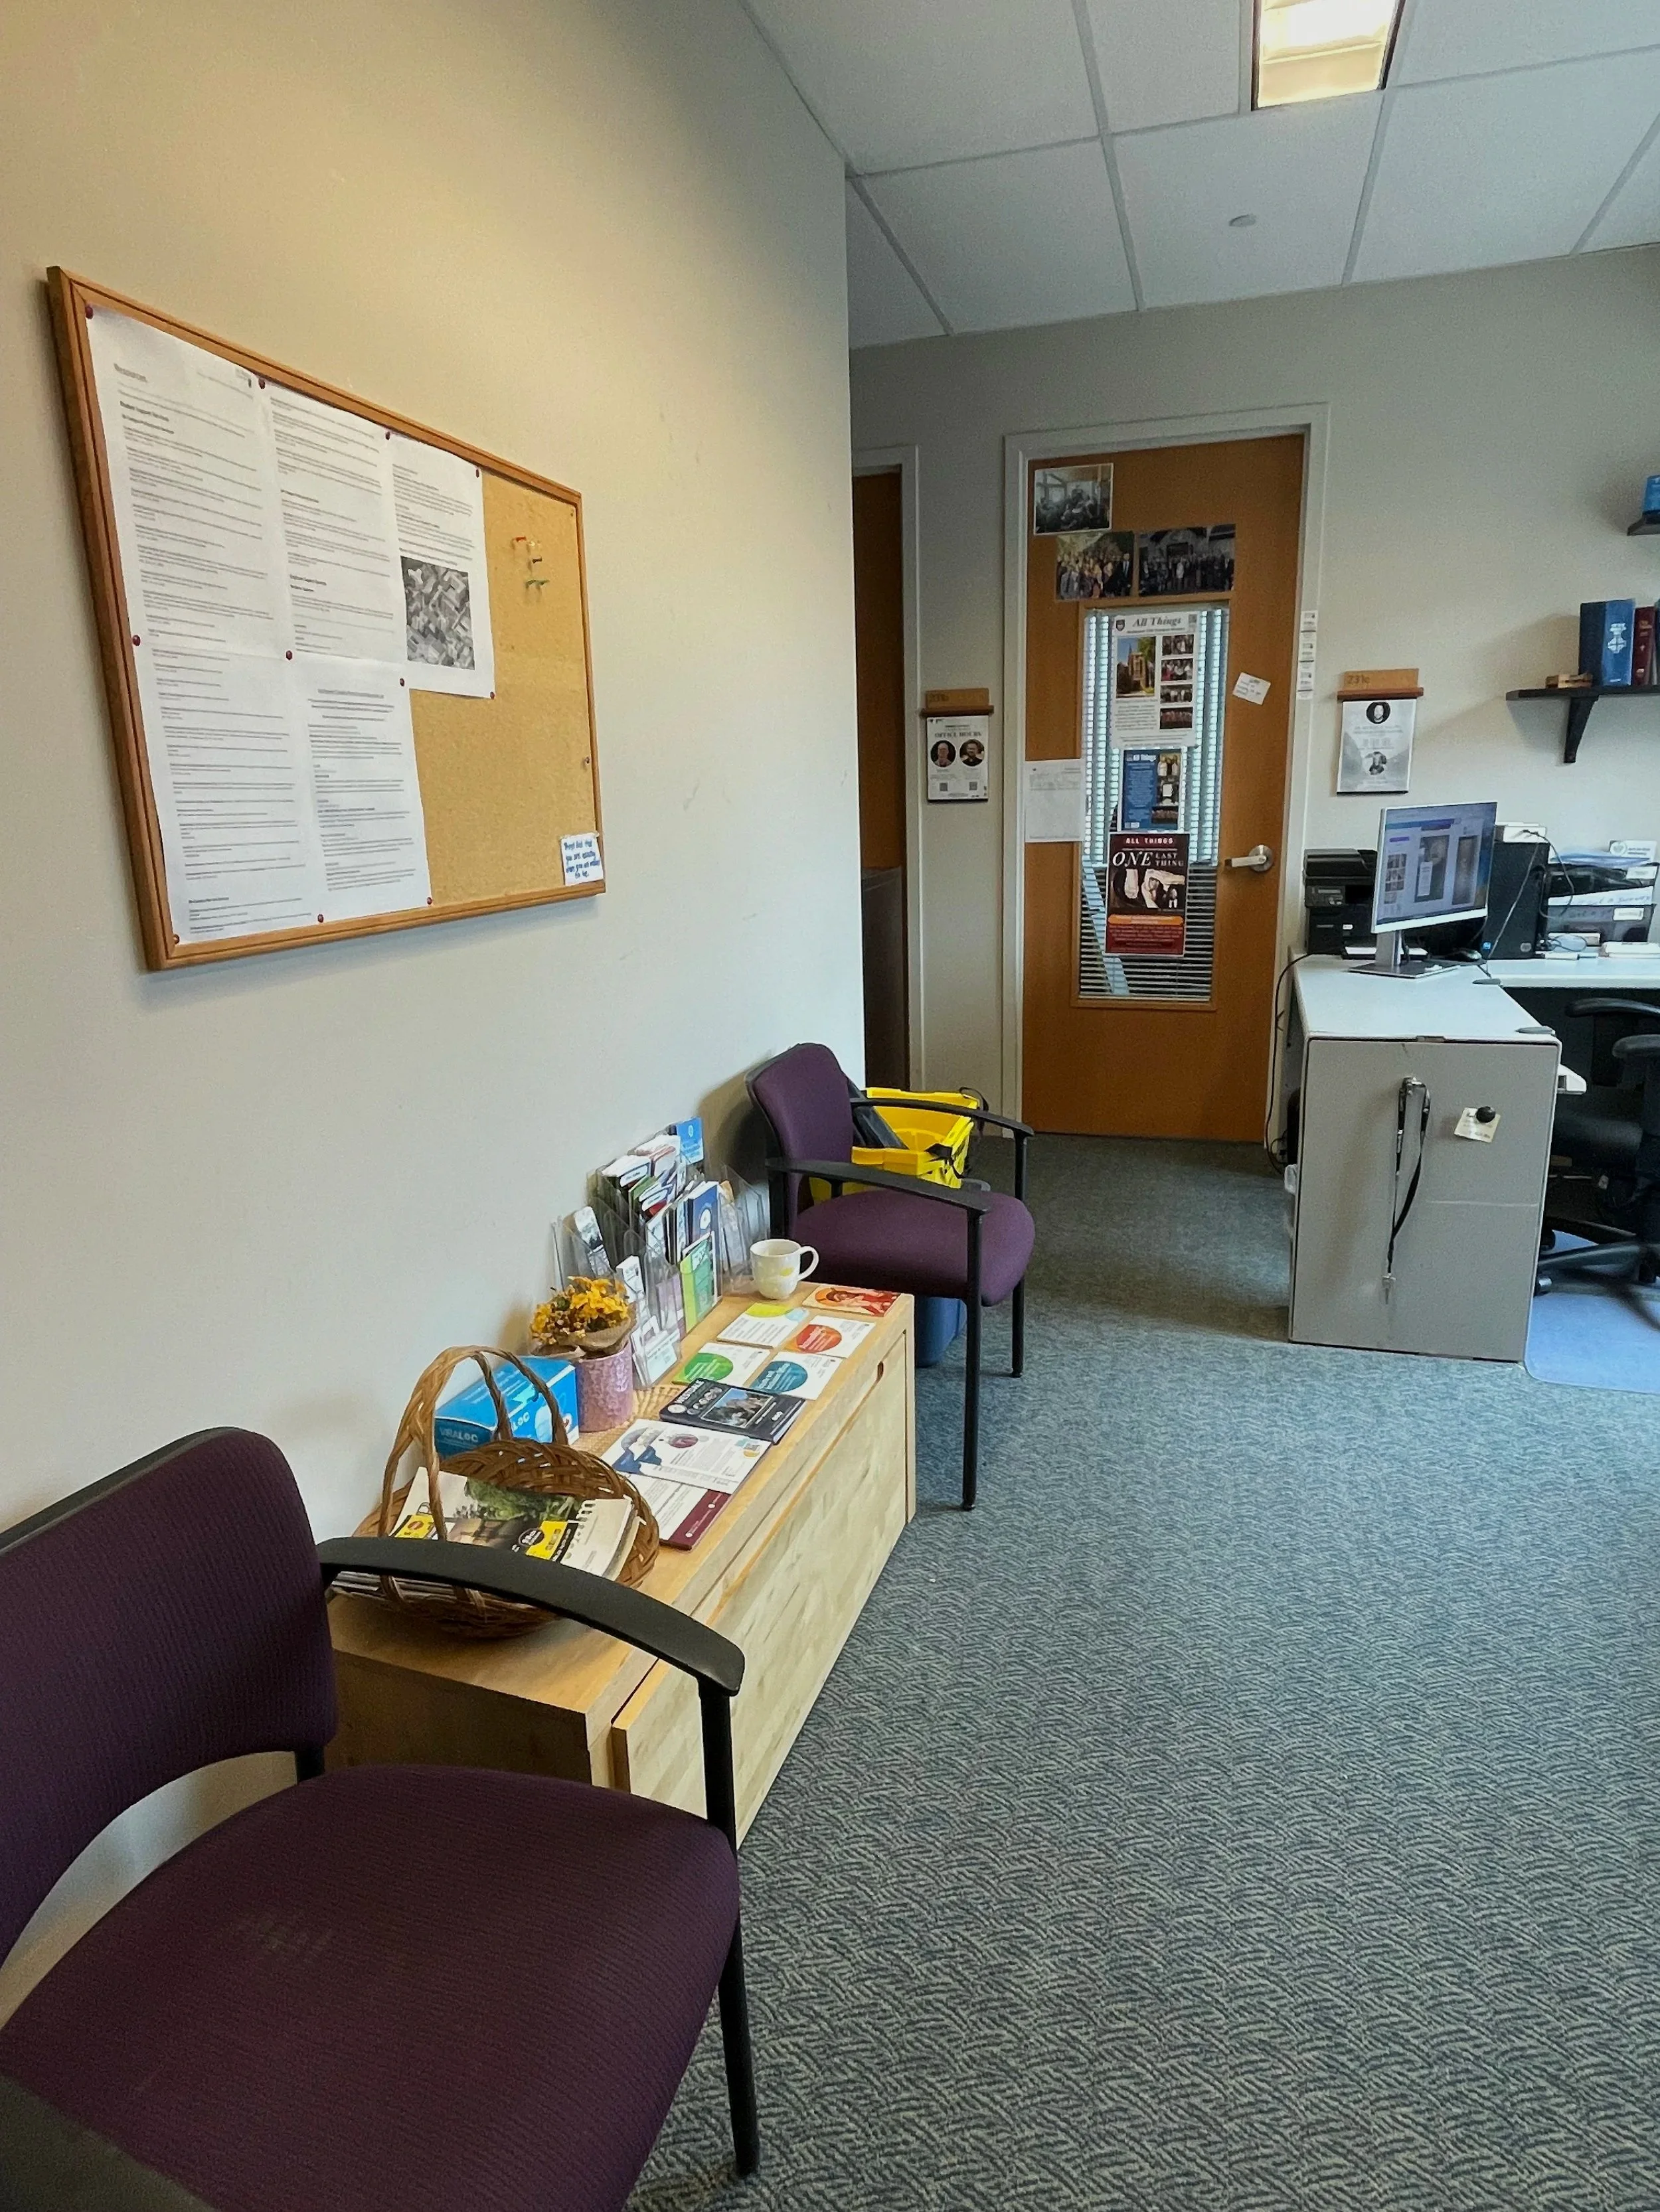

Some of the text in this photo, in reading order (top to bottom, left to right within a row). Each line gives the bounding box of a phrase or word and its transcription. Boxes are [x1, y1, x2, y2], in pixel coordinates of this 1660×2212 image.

[1133, 616, 1182, 627] All Things
[1112, 851, 1153, 868] ONE
